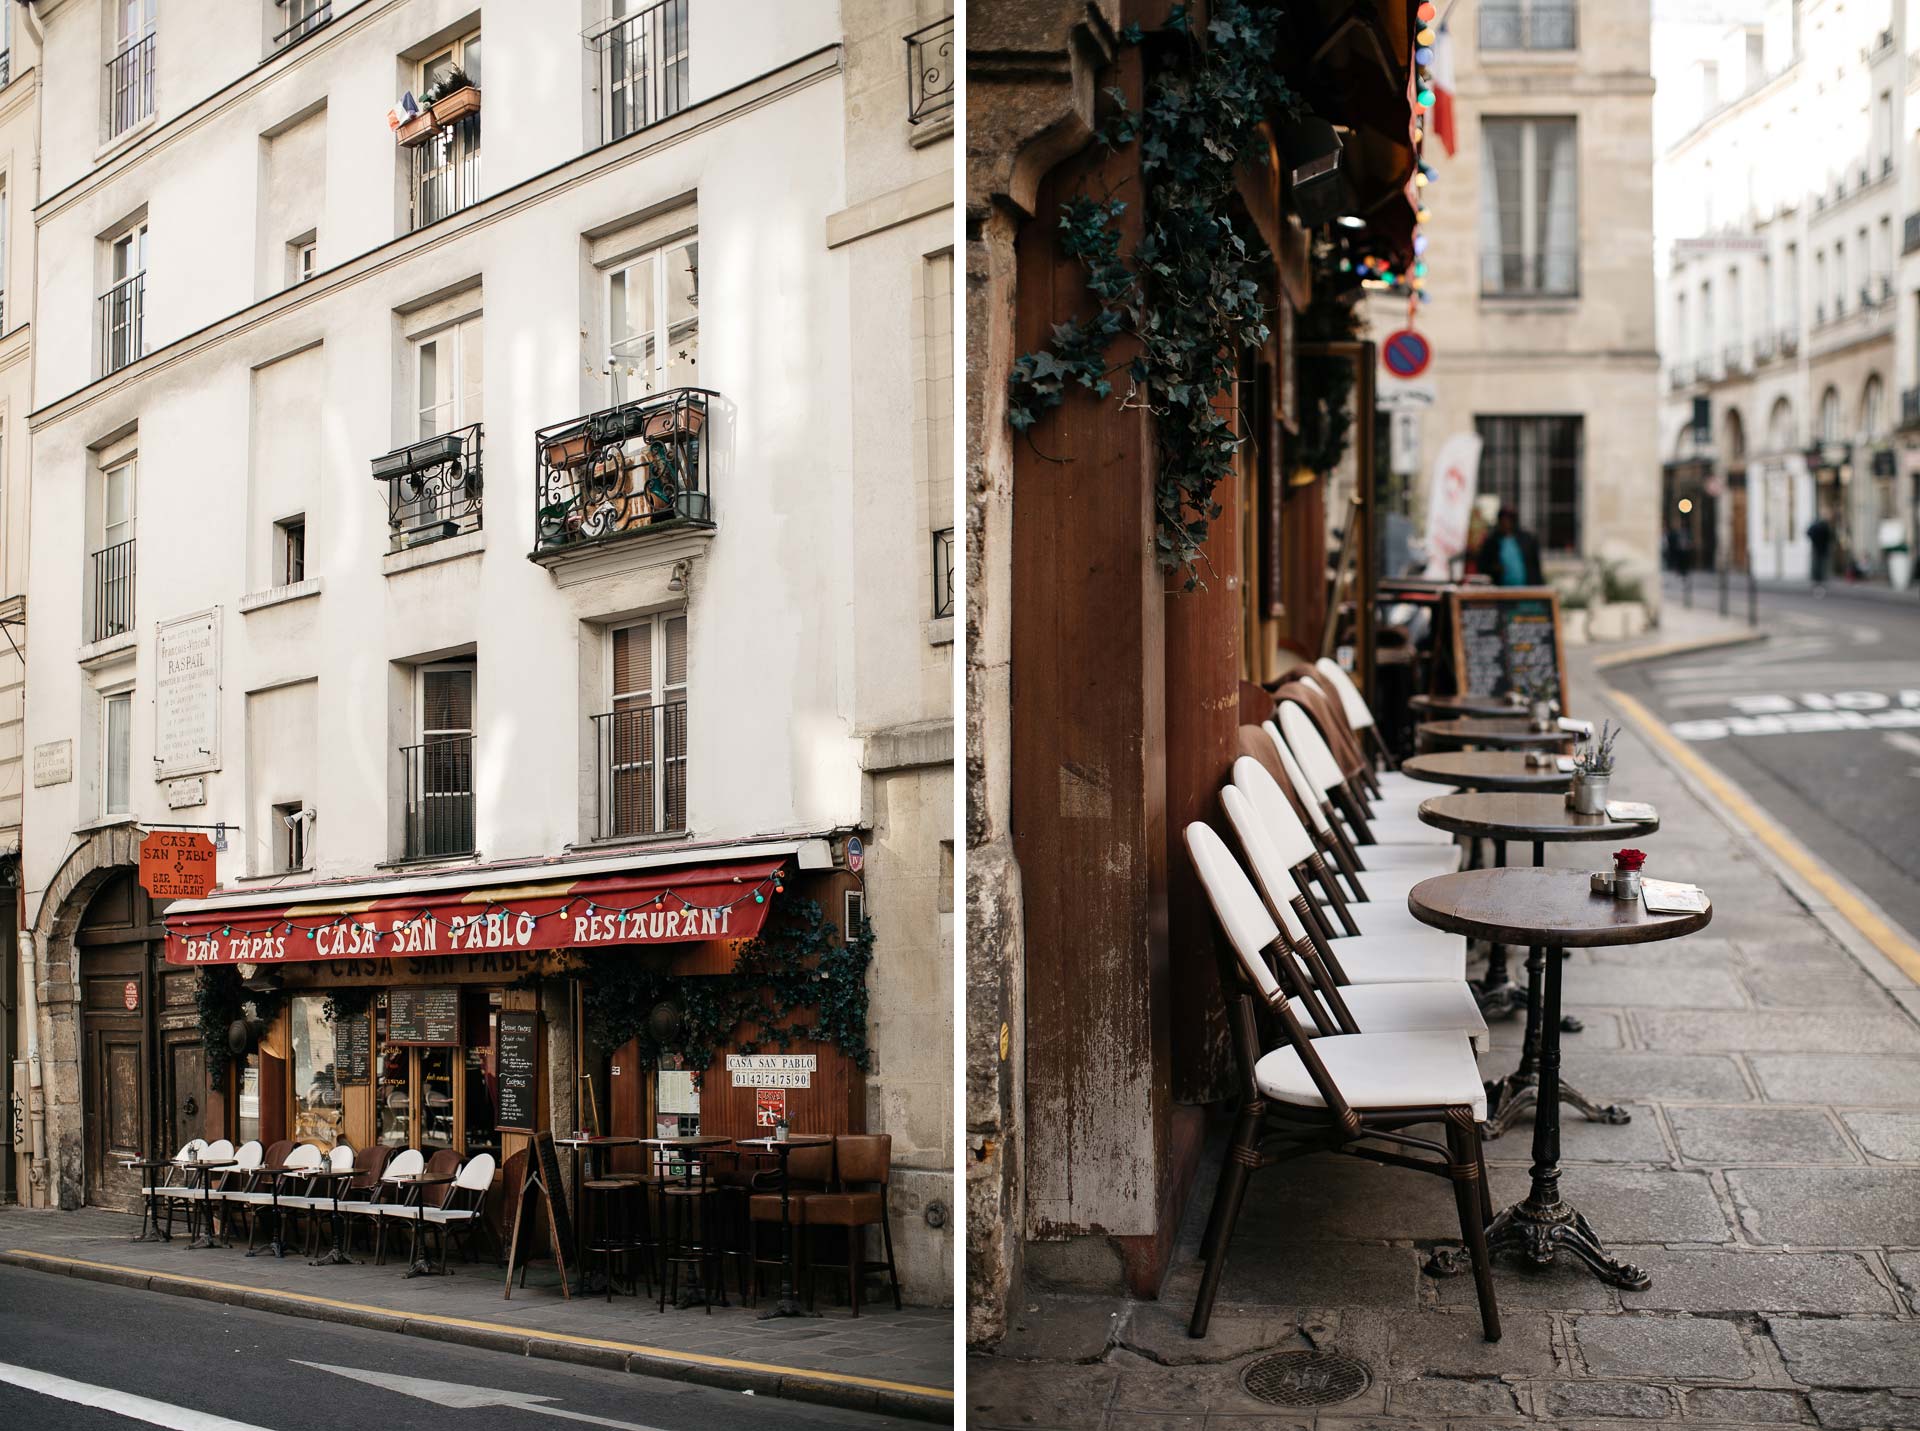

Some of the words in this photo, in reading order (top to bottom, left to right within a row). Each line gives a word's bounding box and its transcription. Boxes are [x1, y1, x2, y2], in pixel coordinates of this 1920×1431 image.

[168, 652, 205, 674] RASPAIL
[160, 835, 196, 847] CASA
[144, 848, 169, 860] SAN
[153, 873, 170, 883] BAR
[178, 874, 204, 884] TAPAS
[153, 884, 204, 896] RESTAURANT
[186, 940, 219, 960] BAR
[229, 937, 285, 959] TAPAS
[316, 922, 376, 956] CASA
[391, 919, 437, 953] SAN
[451, 911, 533, 950] PABLO
[574, 907, 732, 942] RESTAURANT
[330, 957, 393, 978] CASA
[408, 955, 454, 976] SAN
[729, 1058, 752, 1068] CASA
[758, 1058, 776, 1068] SAN
[782, 1058, 813, 1068] PABLO
[736, 1074, 746, 1084] 01
[750, 1074, 761, 1084] 42
[765, 1074, 775, 1084] 74
[780, 1075, 790, 1084] 75
[794, 1075, 806, 1084] 90
